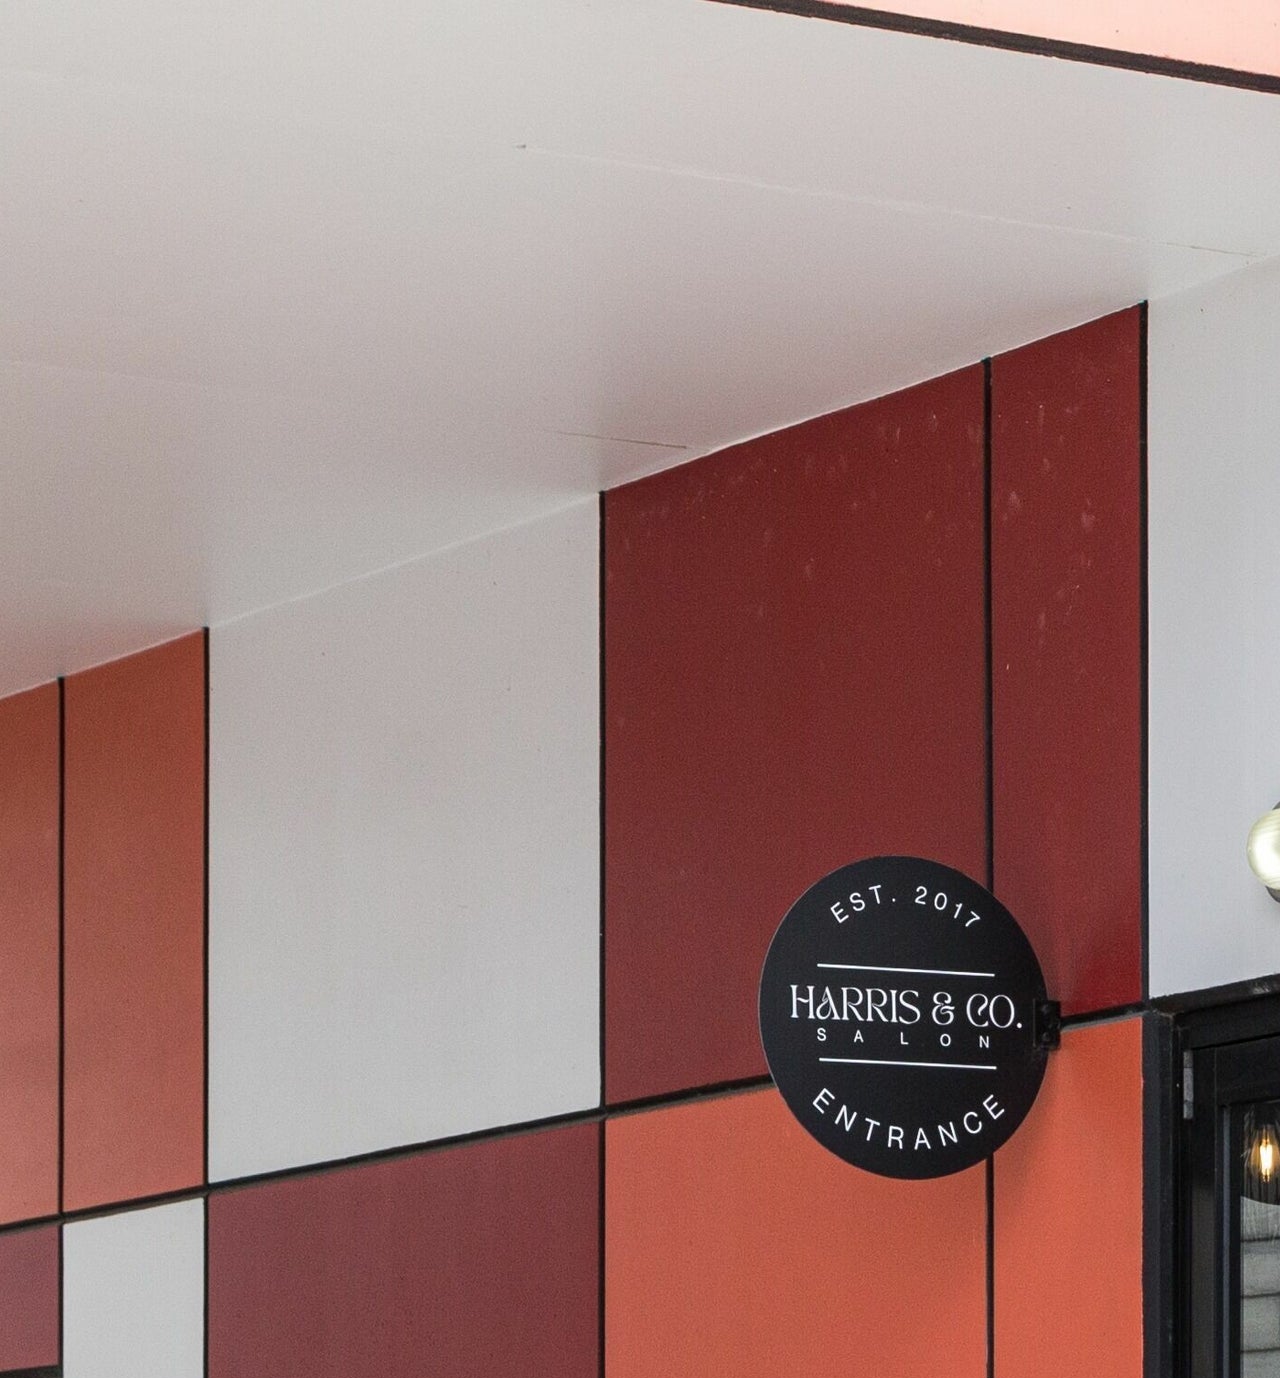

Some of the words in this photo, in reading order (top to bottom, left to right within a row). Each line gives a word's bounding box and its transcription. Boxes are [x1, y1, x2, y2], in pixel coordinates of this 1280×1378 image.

[830, 884, 896, 924] EST.
[914, 885, 981, 928] 2017
[789, 984, 921, 1025] HARRIS
[931, 991, 955, 1026] &
[966, 993, 1023, 1029] CO.
[816, 1027, 990, 1049] SALON
[812, 1087, 1005, 1150] ENTRANCE
